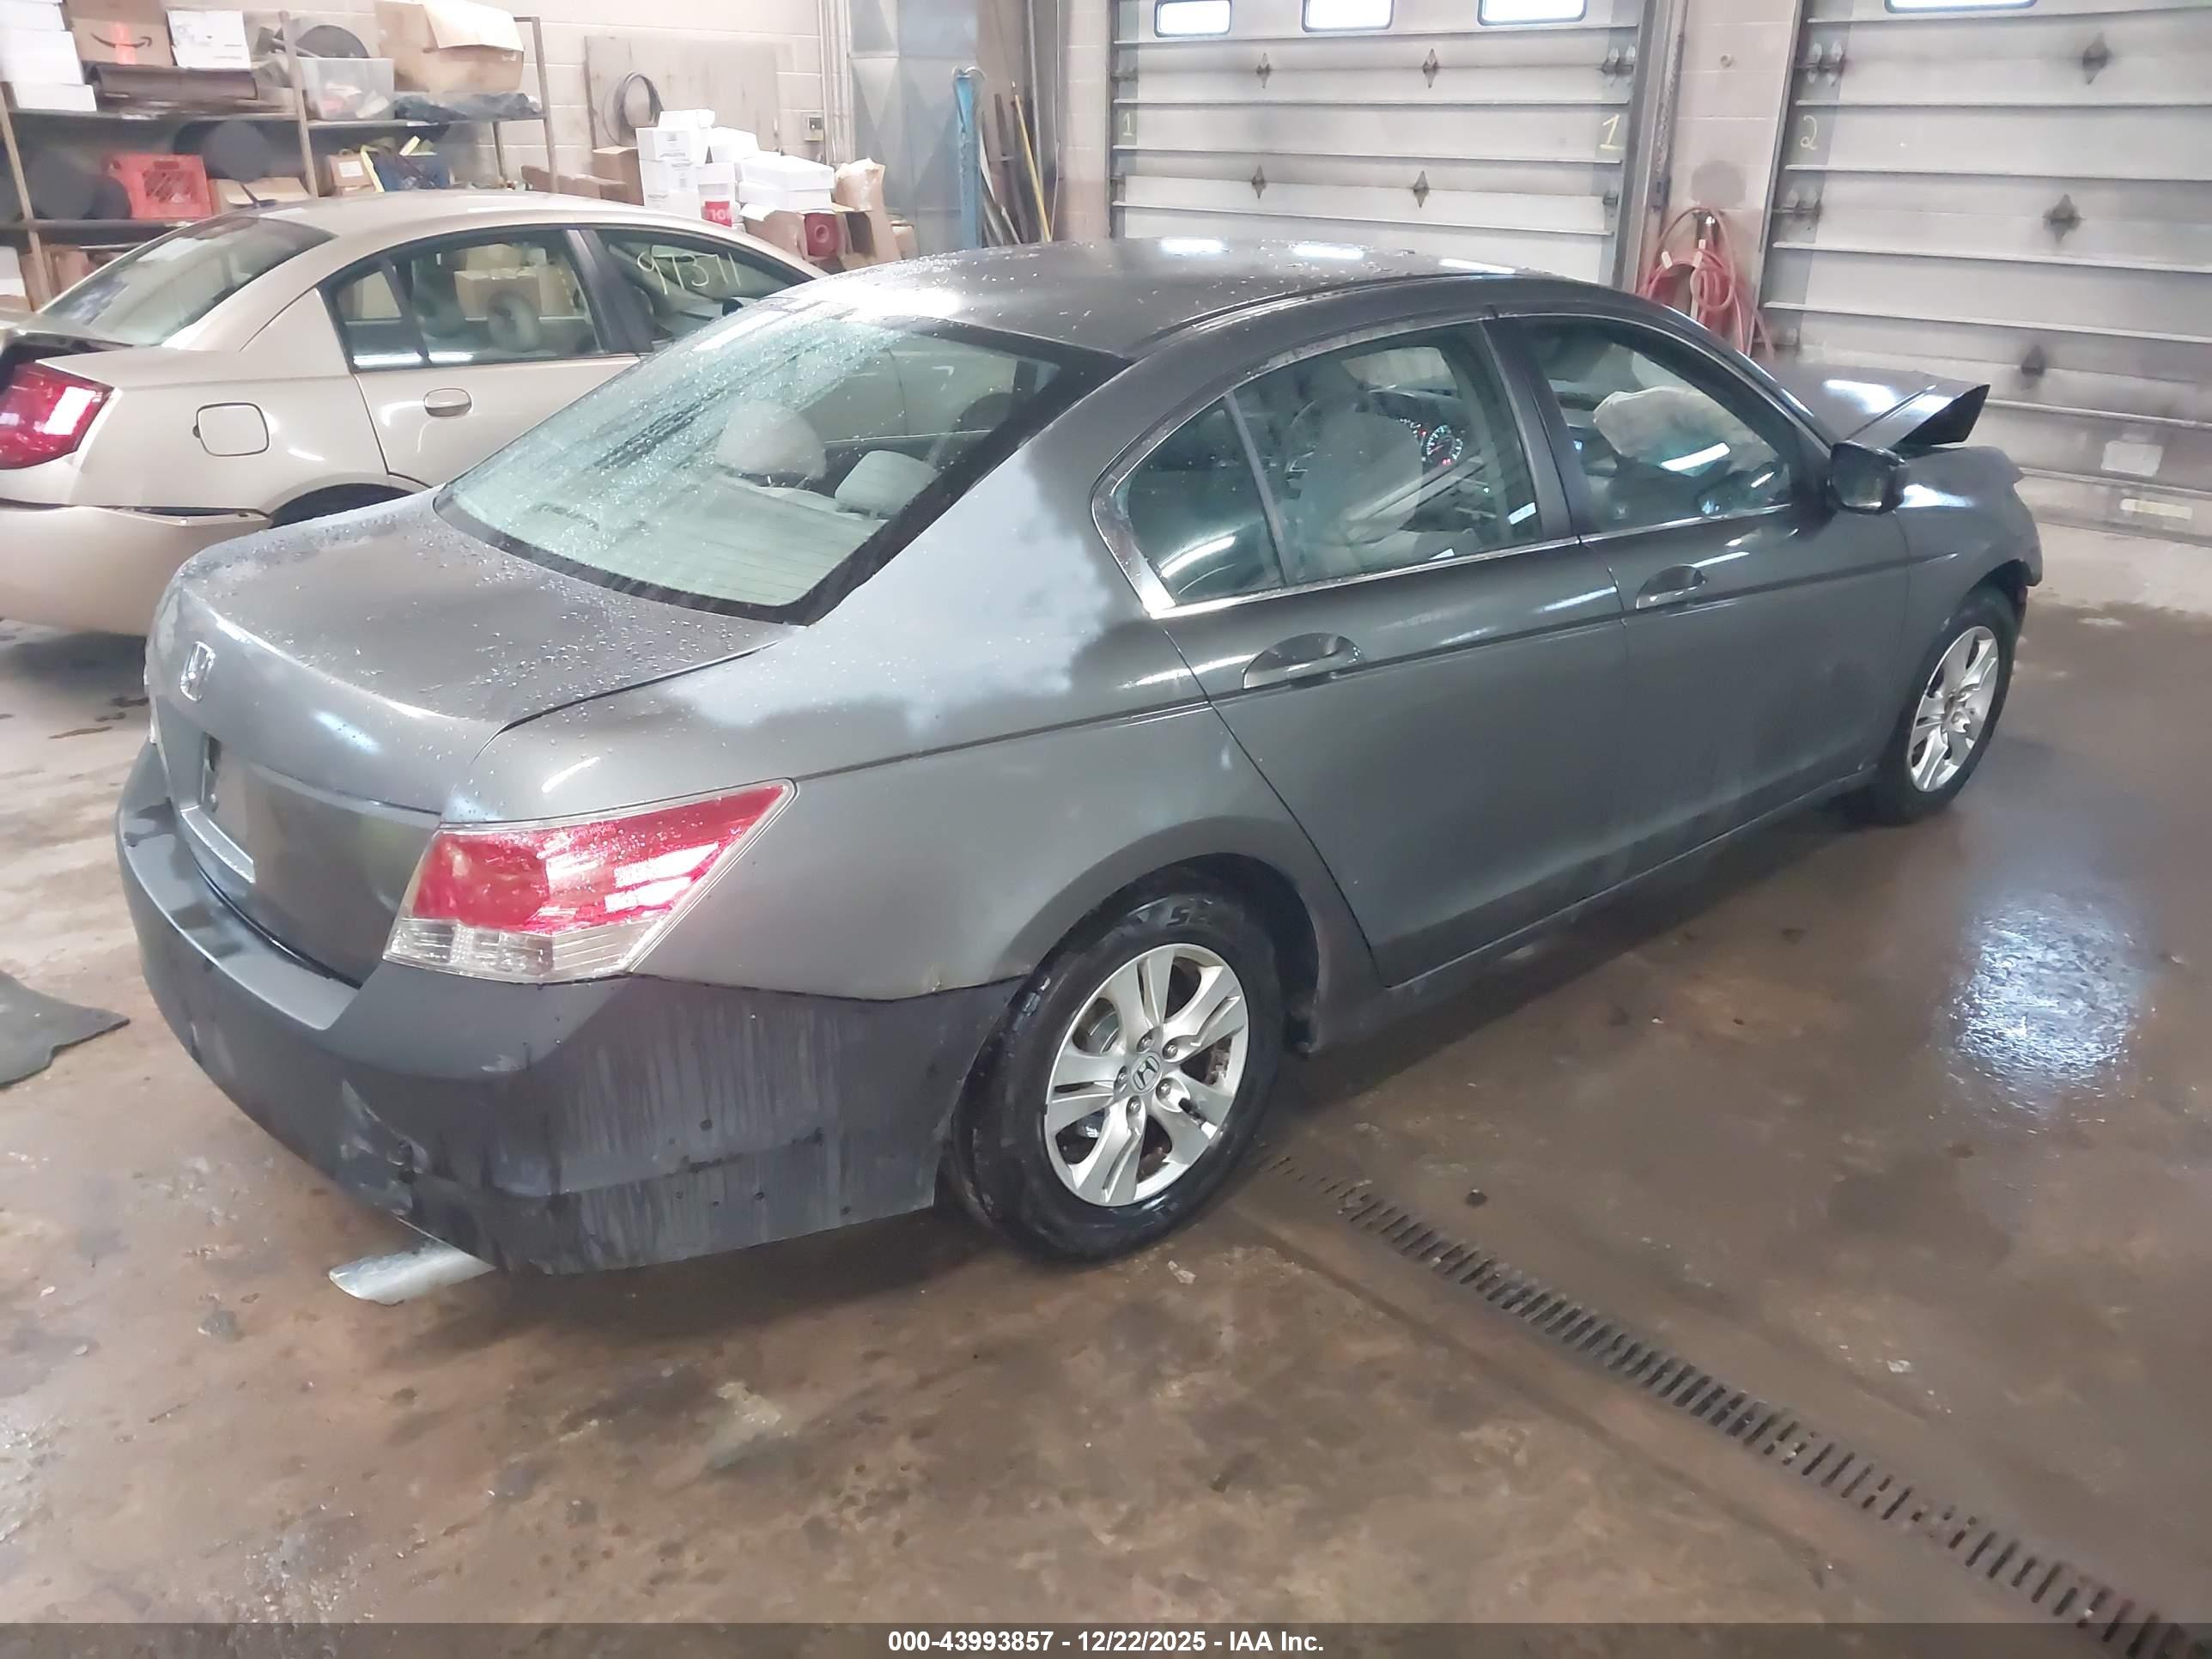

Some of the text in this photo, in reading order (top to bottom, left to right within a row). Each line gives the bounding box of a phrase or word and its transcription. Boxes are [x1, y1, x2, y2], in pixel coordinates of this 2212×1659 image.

[1122, 112, 1133, 137] 1
[1600, 113, 1626, 150] 1
[1800, 114, 1818, 150] 2
